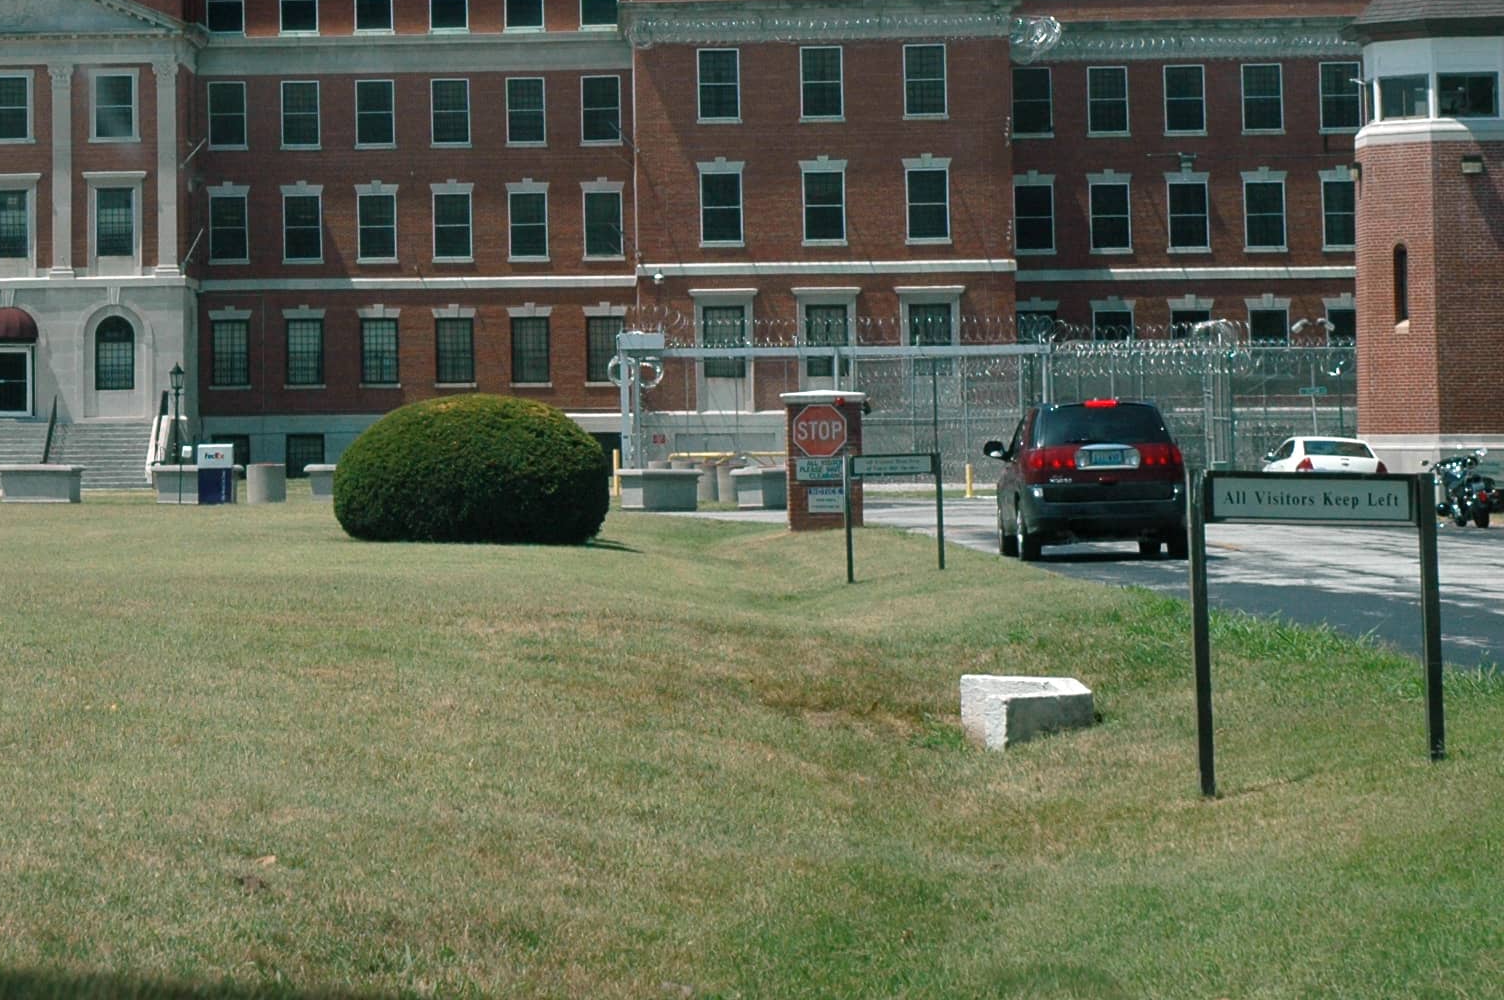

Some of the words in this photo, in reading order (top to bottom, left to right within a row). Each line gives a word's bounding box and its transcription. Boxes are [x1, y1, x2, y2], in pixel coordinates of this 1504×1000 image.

[798, 421, 842, 440] STOP
[1223, 491, 1246, 505] All
[1255, 491, 1315, 506] Visitors
[1322, 491, 1359, 509] Keep
[1367, 492, 1399, 507] Left
